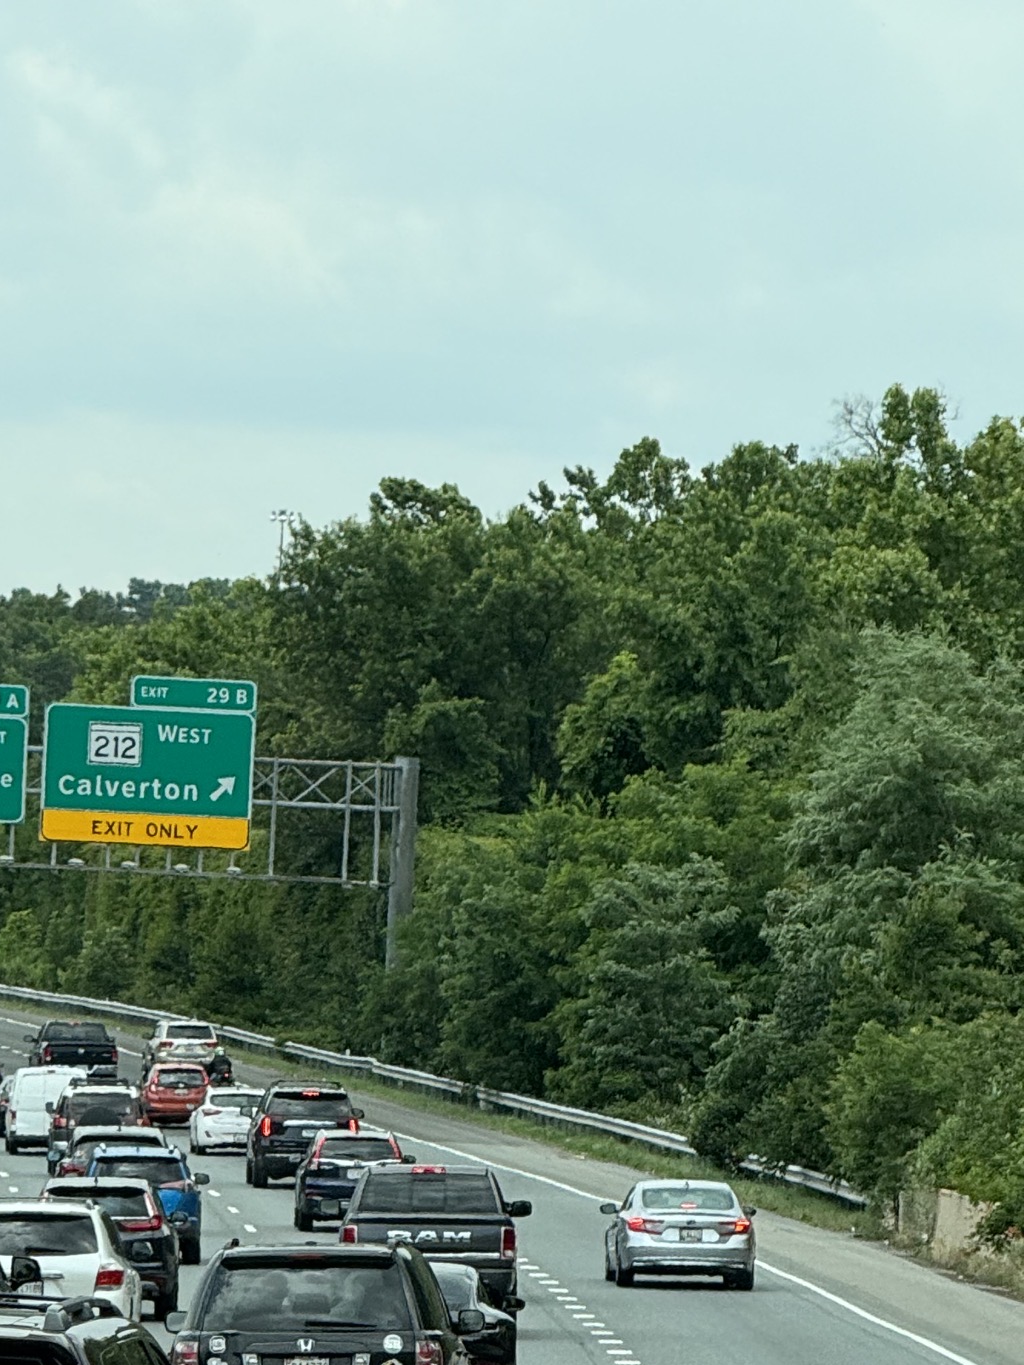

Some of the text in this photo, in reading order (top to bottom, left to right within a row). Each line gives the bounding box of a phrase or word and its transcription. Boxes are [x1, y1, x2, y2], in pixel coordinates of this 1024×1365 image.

[6, 693, 19, 708] A
[140, 686, 247, 704] EXIT 29 B
[94, 724, 212, 760] 212 WEST
[58, 774, 198, 801] Calverton
[91, 820, 199, 839] EXIT ONLY
[387, 1230, 472, 1245] RAM
